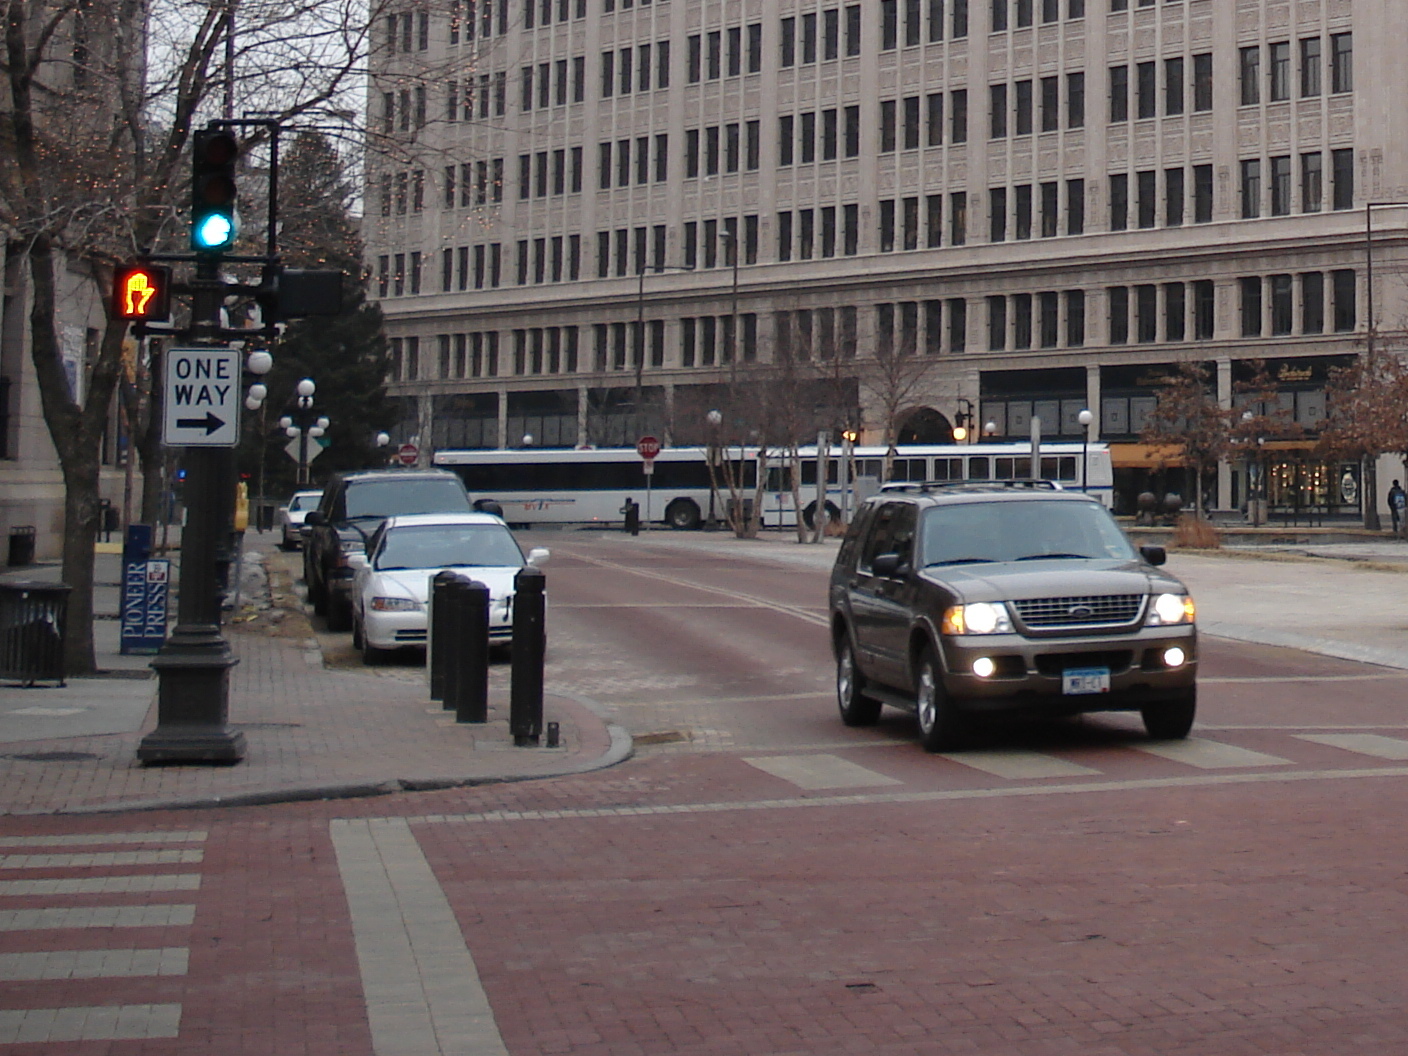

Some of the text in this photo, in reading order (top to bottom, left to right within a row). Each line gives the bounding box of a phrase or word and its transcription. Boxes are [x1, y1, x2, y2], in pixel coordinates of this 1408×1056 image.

[176, 358, 230, 379] ONE
[175, 385, 230, 406] WAY
[638, 443, 659, 453] STOP
[122, 563, 146, 638] PIONEER
[143, 582, 167, 638] PRESS
